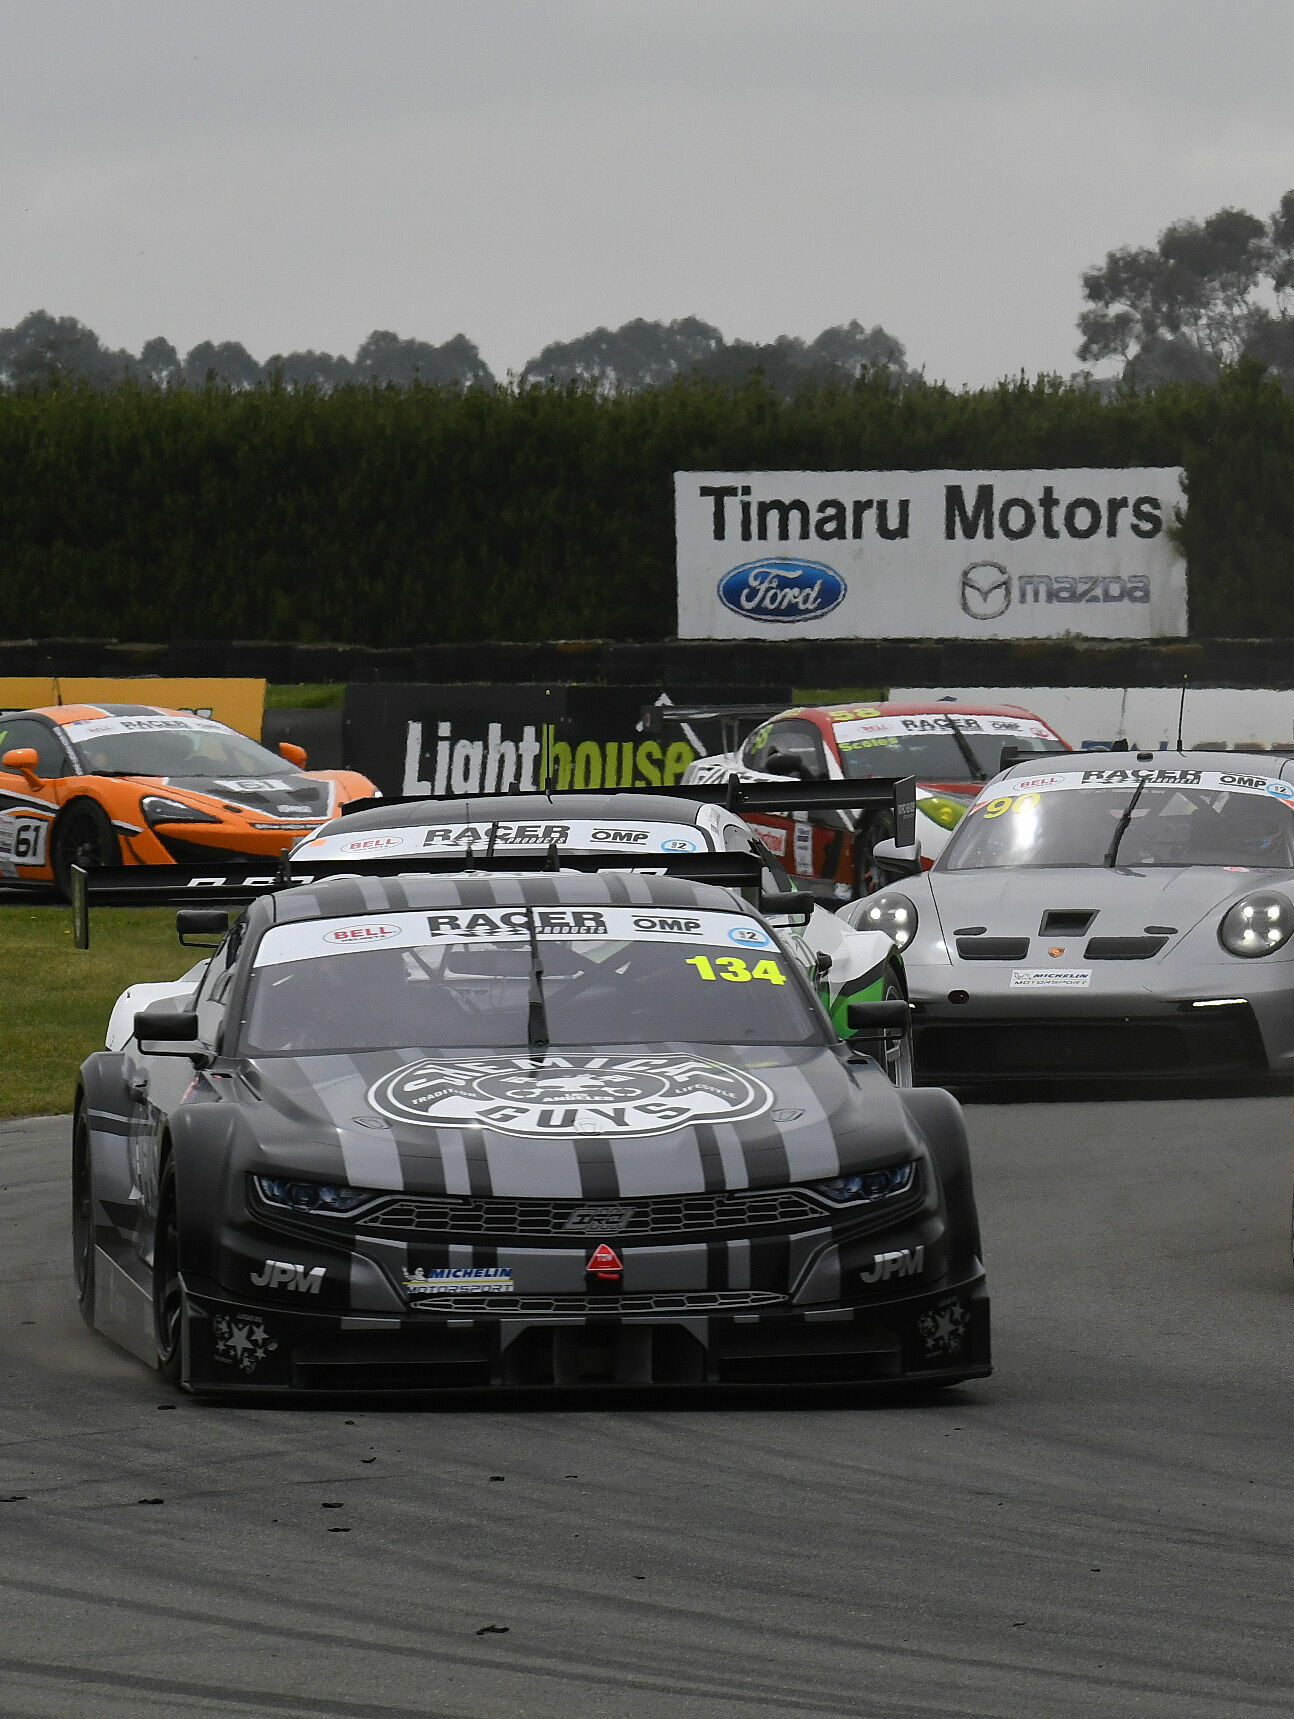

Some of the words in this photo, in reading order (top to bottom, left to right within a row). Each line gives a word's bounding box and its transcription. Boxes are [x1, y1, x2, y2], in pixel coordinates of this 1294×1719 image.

[700, 485, 910, 541] Timaru
[945, 485, 1163, 540] Motors
[741, 568, 822, 611] Ford
[1018, 574, 1151, 604] mazda
[402, 720, 696, 796] Lighthouse
[1020, 777, 1058, 788] BELL
[1083, 770, 1202, 783] RACER
[1220, 775, 1267, 788] OMP
[984, 794, 1041, 819] 90
[15, 825, 41, 857] 61
[350, 837, 396, 850] BELL
[424, 825, 571, 846] RACER
[591, 831, 649, 843] OMP
[334, 926, 396, 940] BELL
[427, 911, 606, 931] RACER
[634, 918, 701, 933] OMP
[536, 925, 606, 935] PRODUCTS
[685, 955, 787, 985] 134
[475, 1102, 692, 1128] GUYS
[250, 1260, 326, 1294] JPM
[430, 1268, 513, 1278] MICHELIN
[861, 1246, 924, 1284] JPM
[407, 1285, 513, 1293] MOTORSPORT
